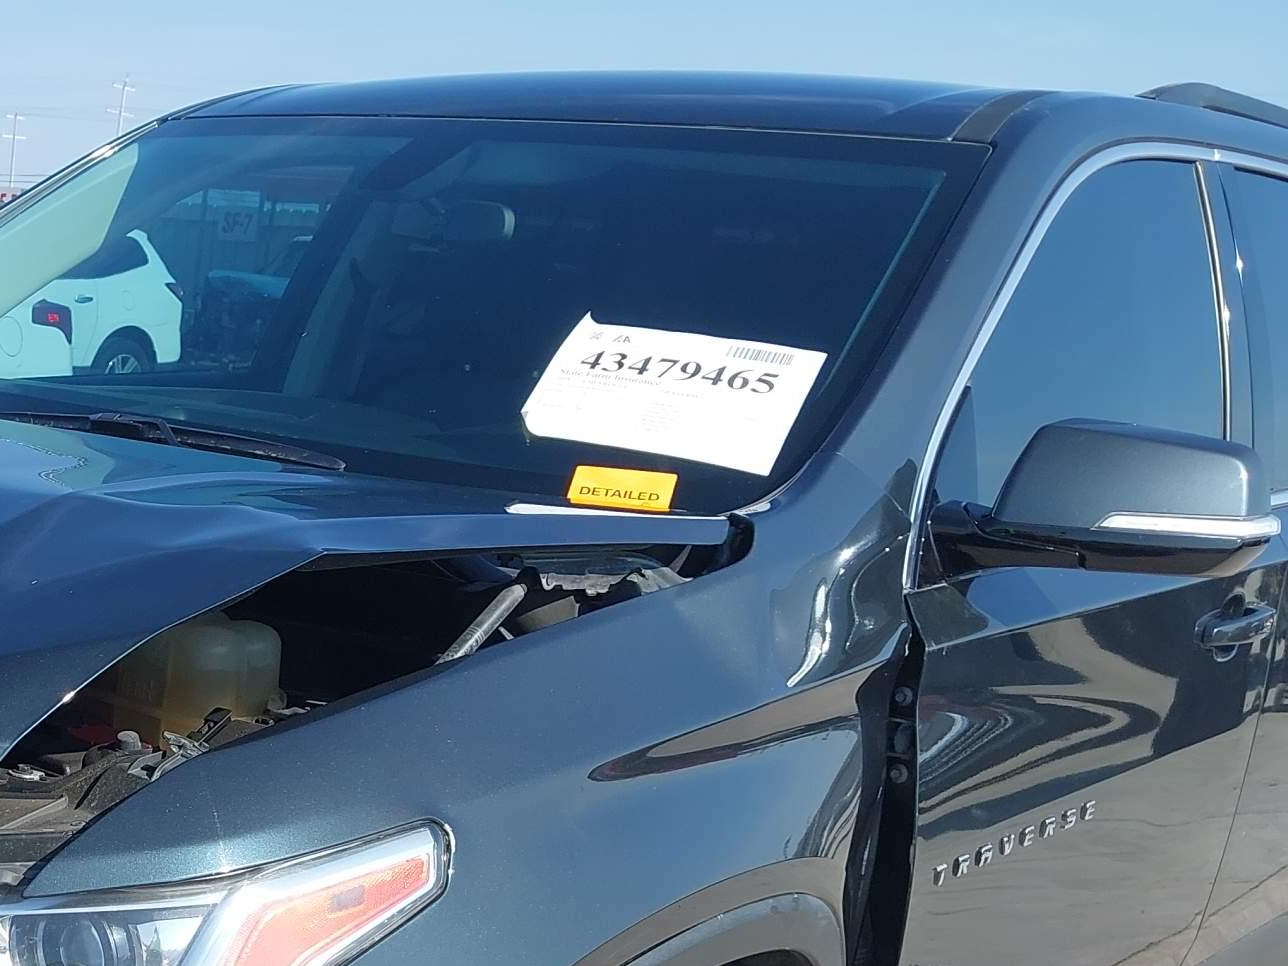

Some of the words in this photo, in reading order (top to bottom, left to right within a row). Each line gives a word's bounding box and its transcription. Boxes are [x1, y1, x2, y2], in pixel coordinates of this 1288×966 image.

[580, 350, 779, 394] 43479465
[578, 486, 661, 502] DETAILED
[932, 800, 1097, 887] TRAVERSE
